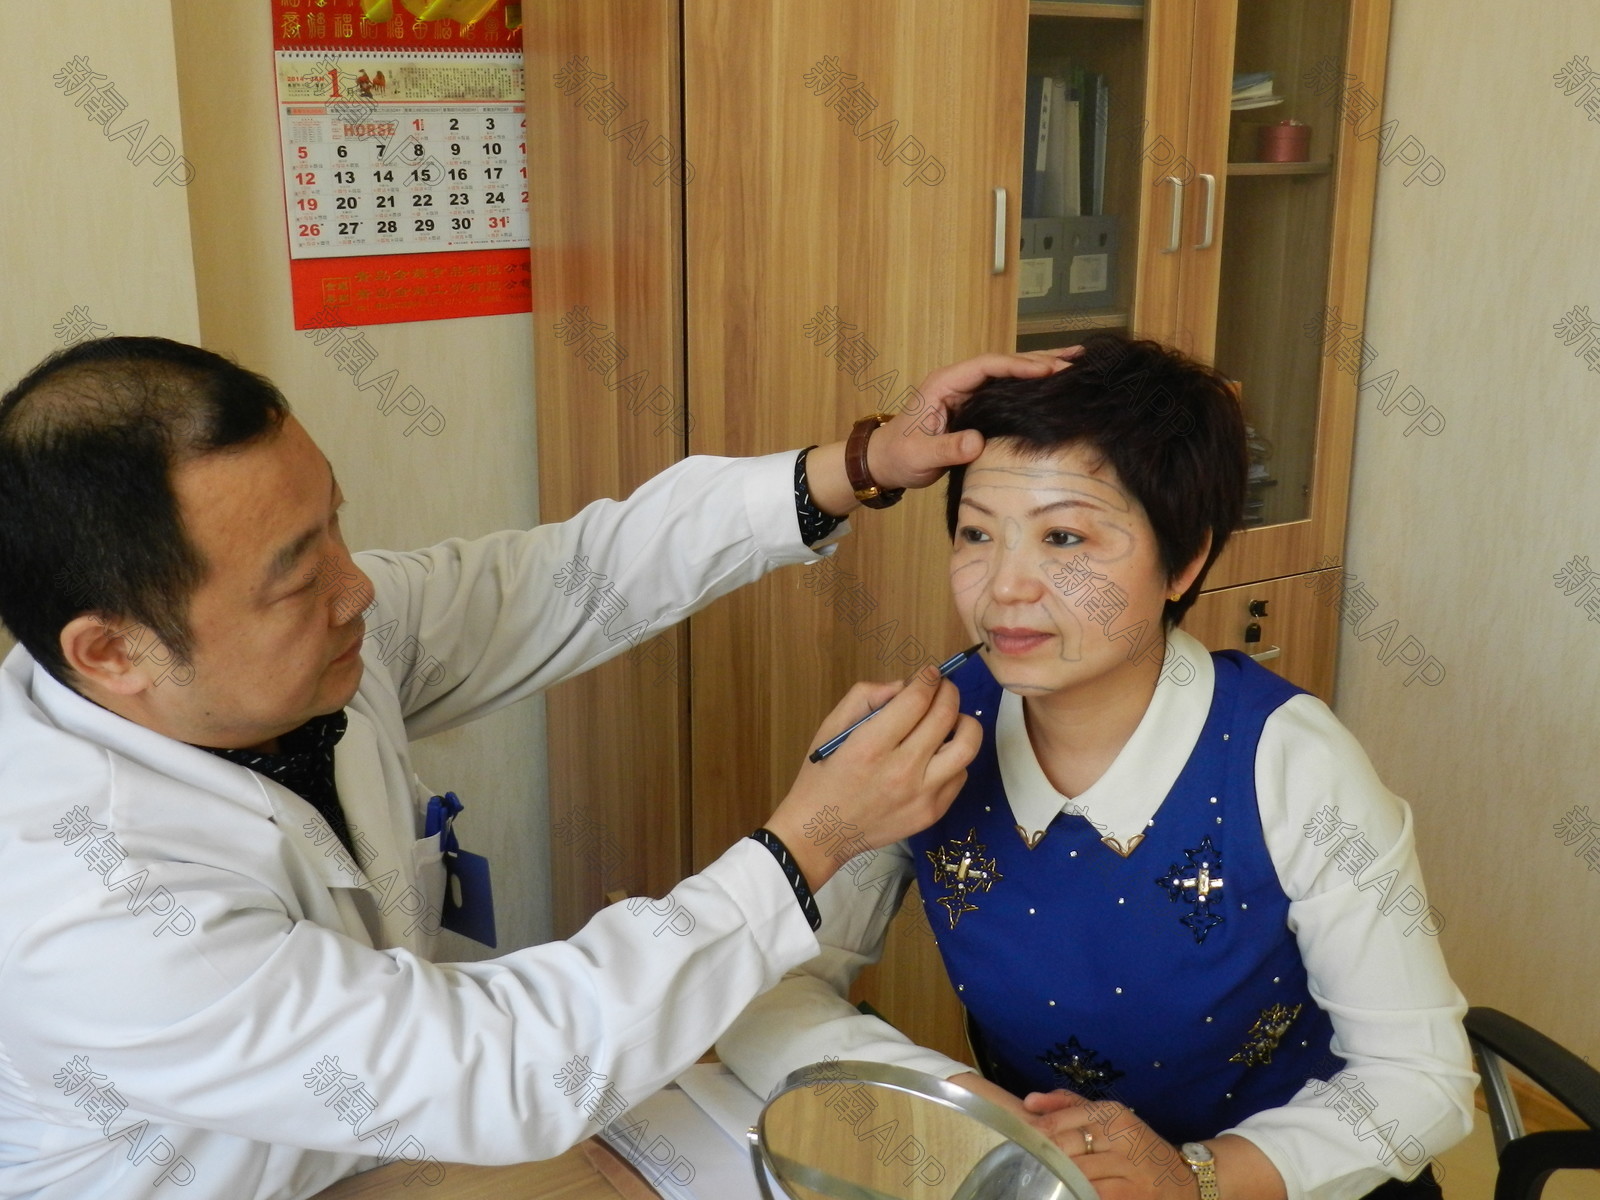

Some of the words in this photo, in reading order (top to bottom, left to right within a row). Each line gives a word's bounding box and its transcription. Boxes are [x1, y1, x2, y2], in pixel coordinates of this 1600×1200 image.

[328, 68, 343, 97] 1
[343, 123, 396, 136] HORSE
[412, 119, 420, 131] 1
[450, 119, 459, 130] 2
[486, 118, 495, 130] 3
[298, 146, 308, 159] 5
[337, 146, 347, 158] 6
[376, 145, 386, 157] 7
[414, 144, 423, 156] 8
[451, 144, 461, 155] 9
[482, 143, 501, 155] 10
[519, 143, 527, 154] 1
[296, 172, 316, 185] 12
[334, 172, 355, 184] 13
[374, 170, 394, 183] 14
[411, 169, 431, 181] 15
[448, 169, 468, 181] 16
[484, 168, 503, 180] 17
[520, 167, 527, 179] 1
[297, 198, 318, 211] 19
[336, 197, 357, 210] 20
[376, 196, 395, 208] 21
[413, 194, 433, 207] 22
[450, 193, 469, 205] 23
[486, 192, 505, 204] 24
[521, 191, 529, 203] 2
[299, 224, 320, 237] 26
[338, 222, 359, 235] 27
[377, 221, 397, 233] 28
[415, 219, 435, 231] 29
[452, 218, 471, 230] 30
[489, 217, 506, 229] 31
